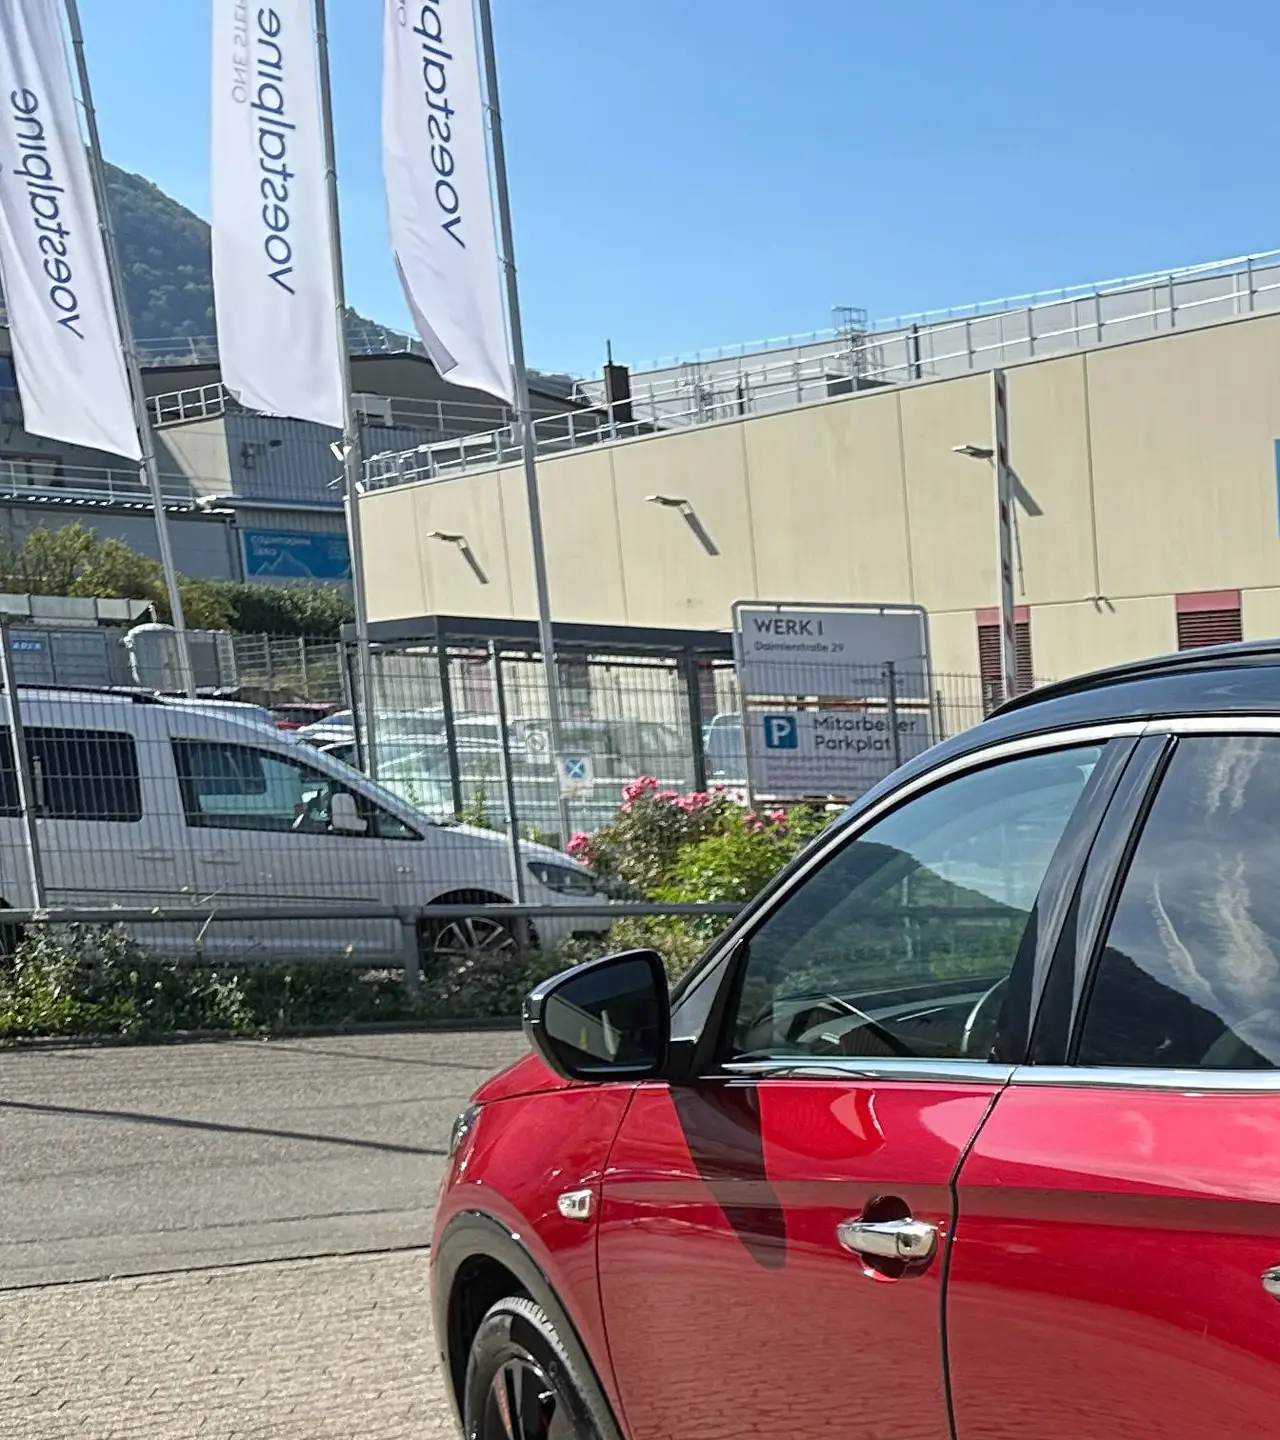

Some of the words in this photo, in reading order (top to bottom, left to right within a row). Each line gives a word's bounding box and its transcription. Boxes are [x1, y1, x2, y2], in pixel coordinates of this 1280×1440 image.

[754, 618, 813, 636] WERK
[813, 715, 917, 733] Mitarbeier
[815, 735, 895, 753] Parkplat
